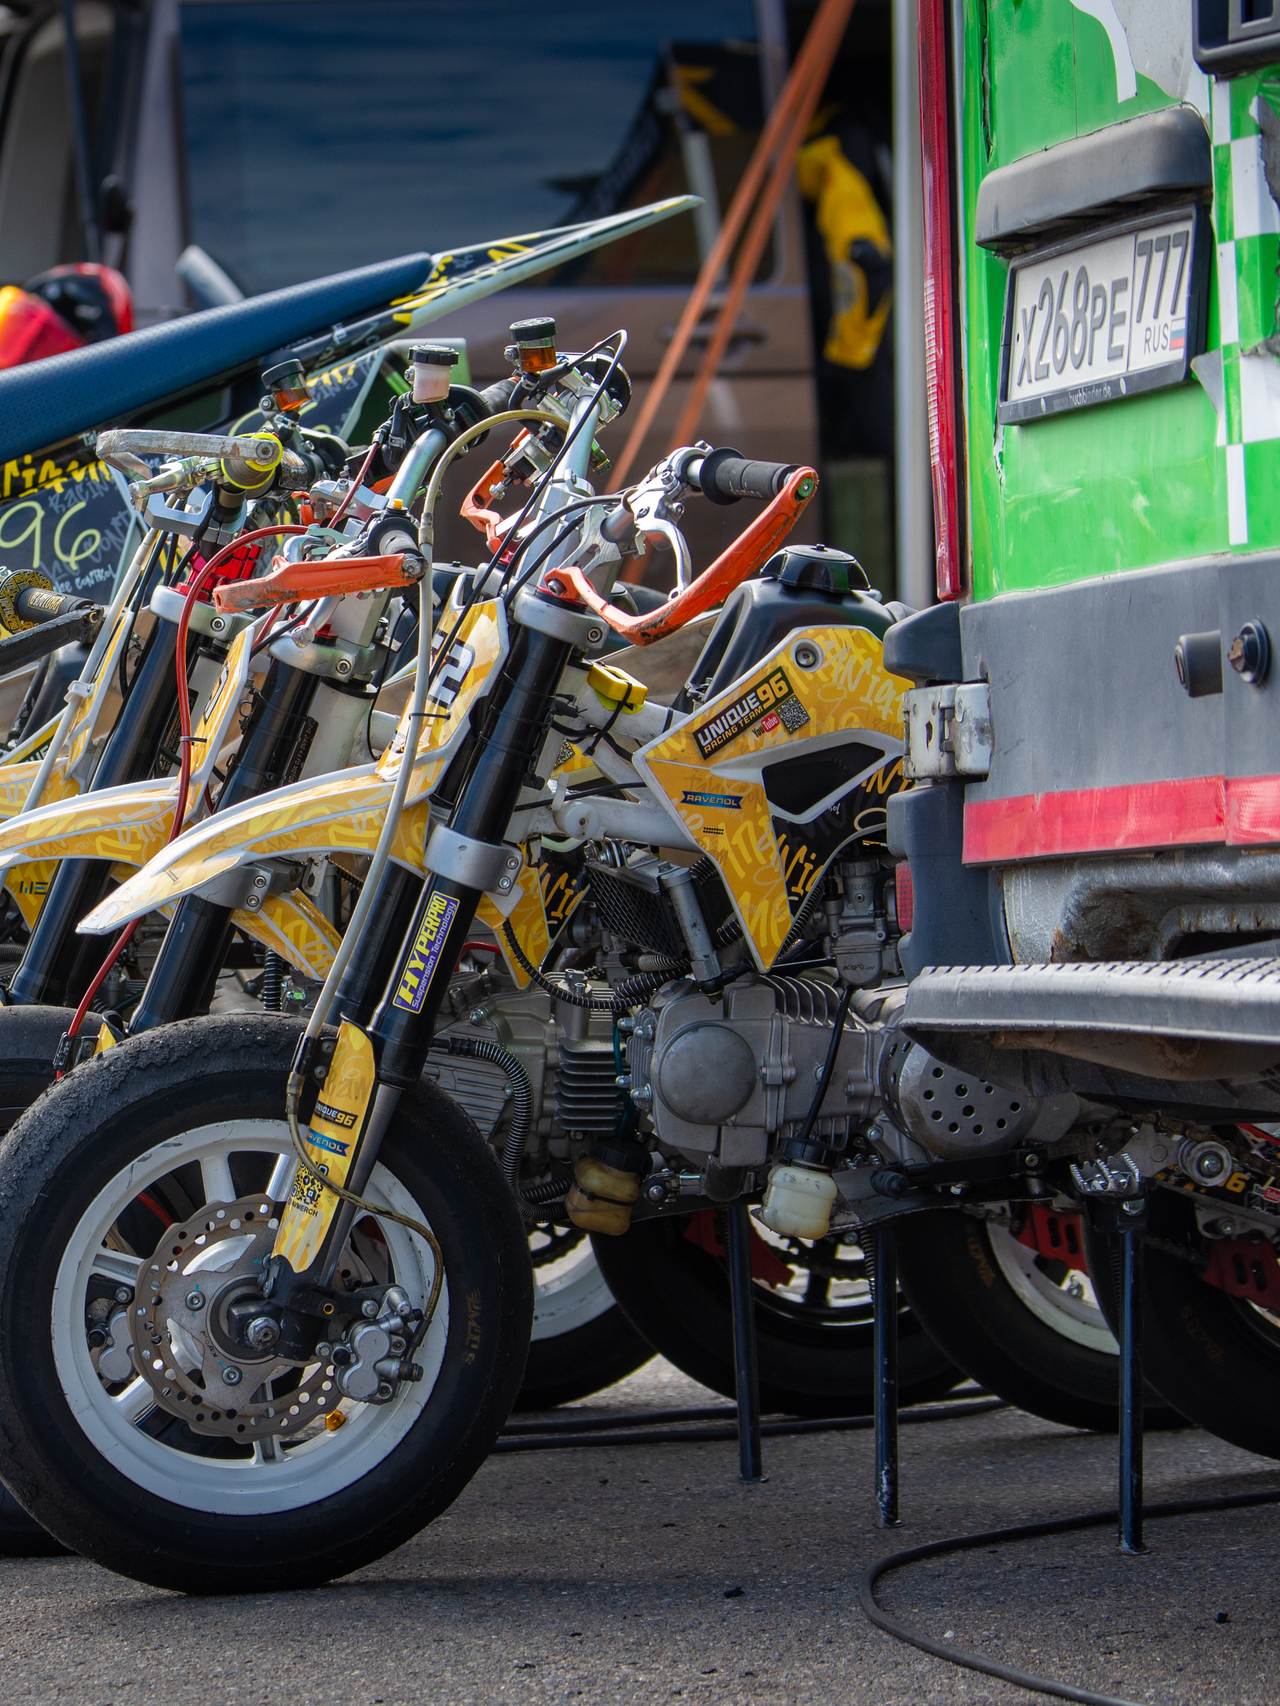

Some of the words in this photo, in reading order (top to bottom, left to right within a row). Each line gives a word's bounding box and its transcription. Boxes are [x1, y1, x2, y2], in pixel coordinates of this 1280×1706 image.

[1136, 229, 1189, 324] 777
[1016, 264, 1129, 387] X268PE
[1143, 322, 1169, 355] RUS
[697, 671, 789, 747] UNIQUE96
[703, 725, 738, 754] RACING
[738, 705, 764, 728] TEAM
[686, 794, 738, 807] RAVENOL
[399, 895, 448, 1005] HYPERPRO
[411, 955, 436, 1009] Suspension
[431, 902, 457, 953] Technology
